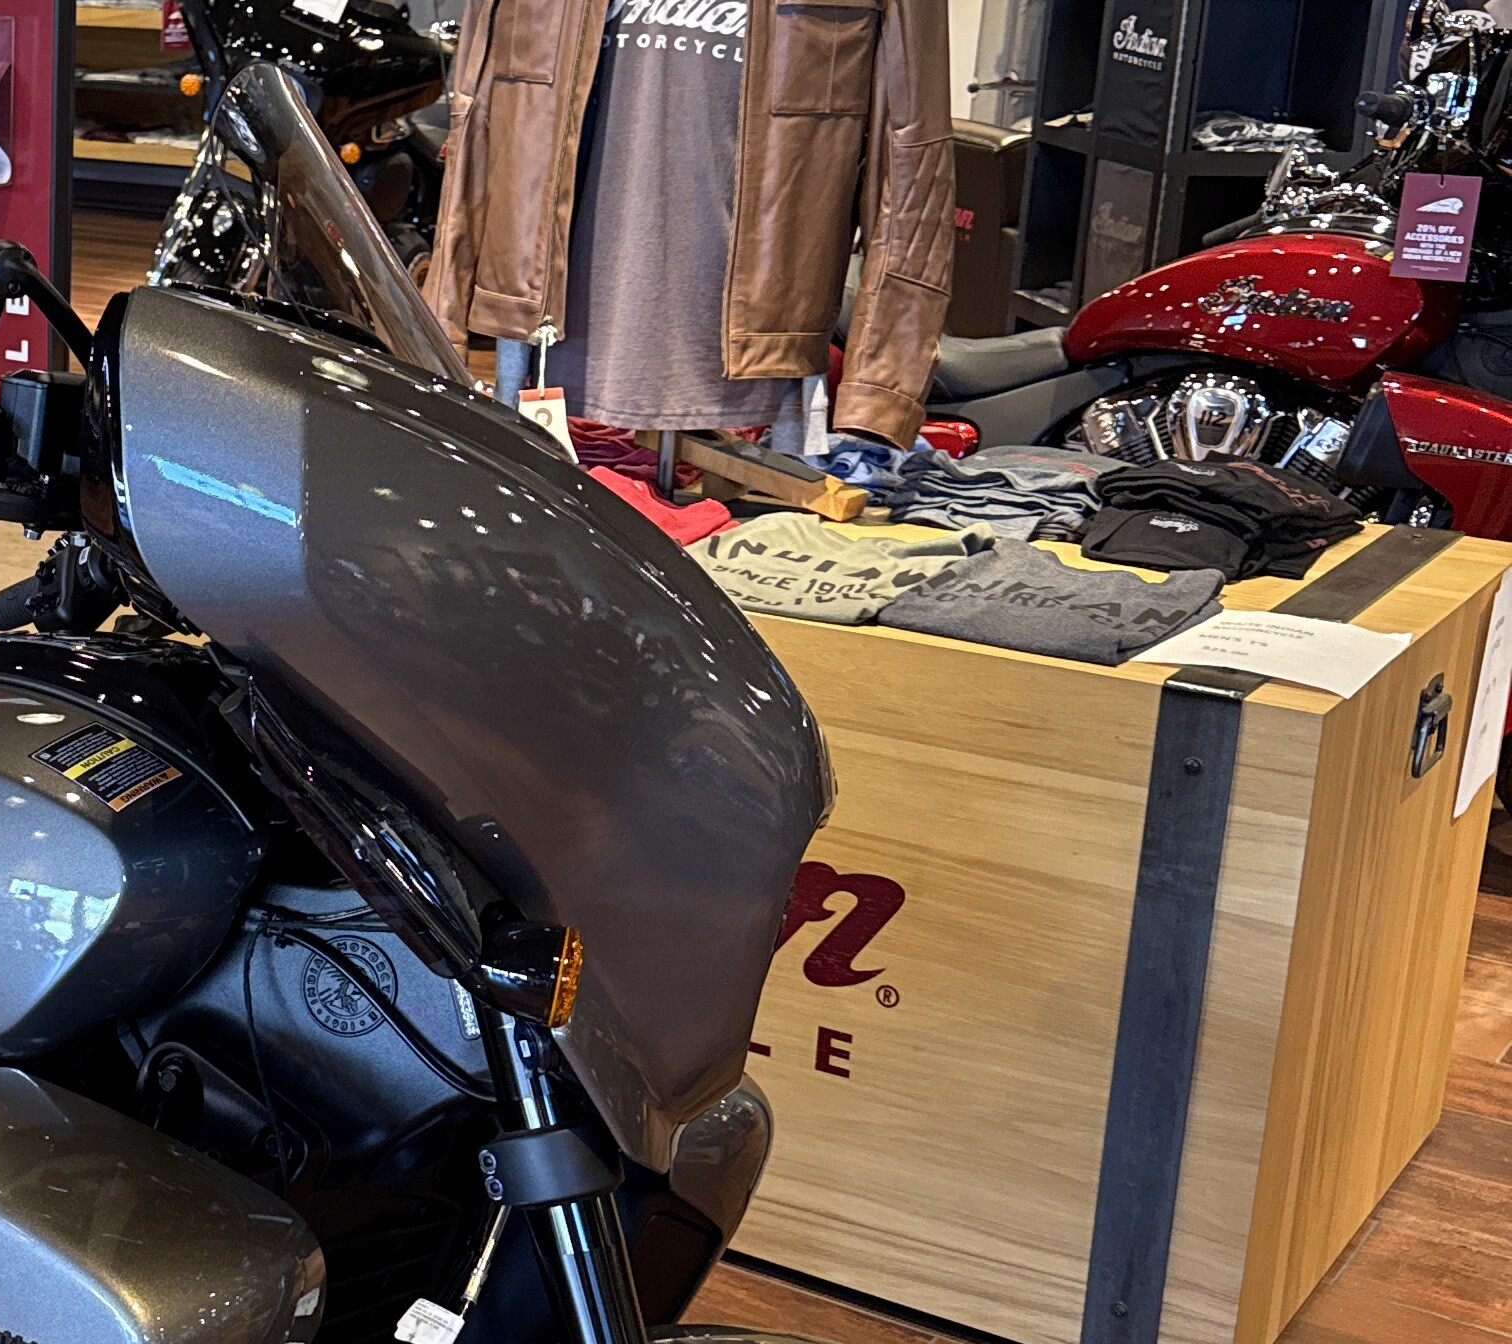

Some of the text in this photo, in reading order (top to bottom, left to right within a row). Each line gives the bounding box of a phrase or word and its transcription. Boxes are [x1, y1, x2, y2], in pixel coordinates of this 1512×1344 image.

[1198, 274, 1354, 323] Indian
[712, 565, 799, 591] SINCE
[80, 747, 121, 769] CAUTION
